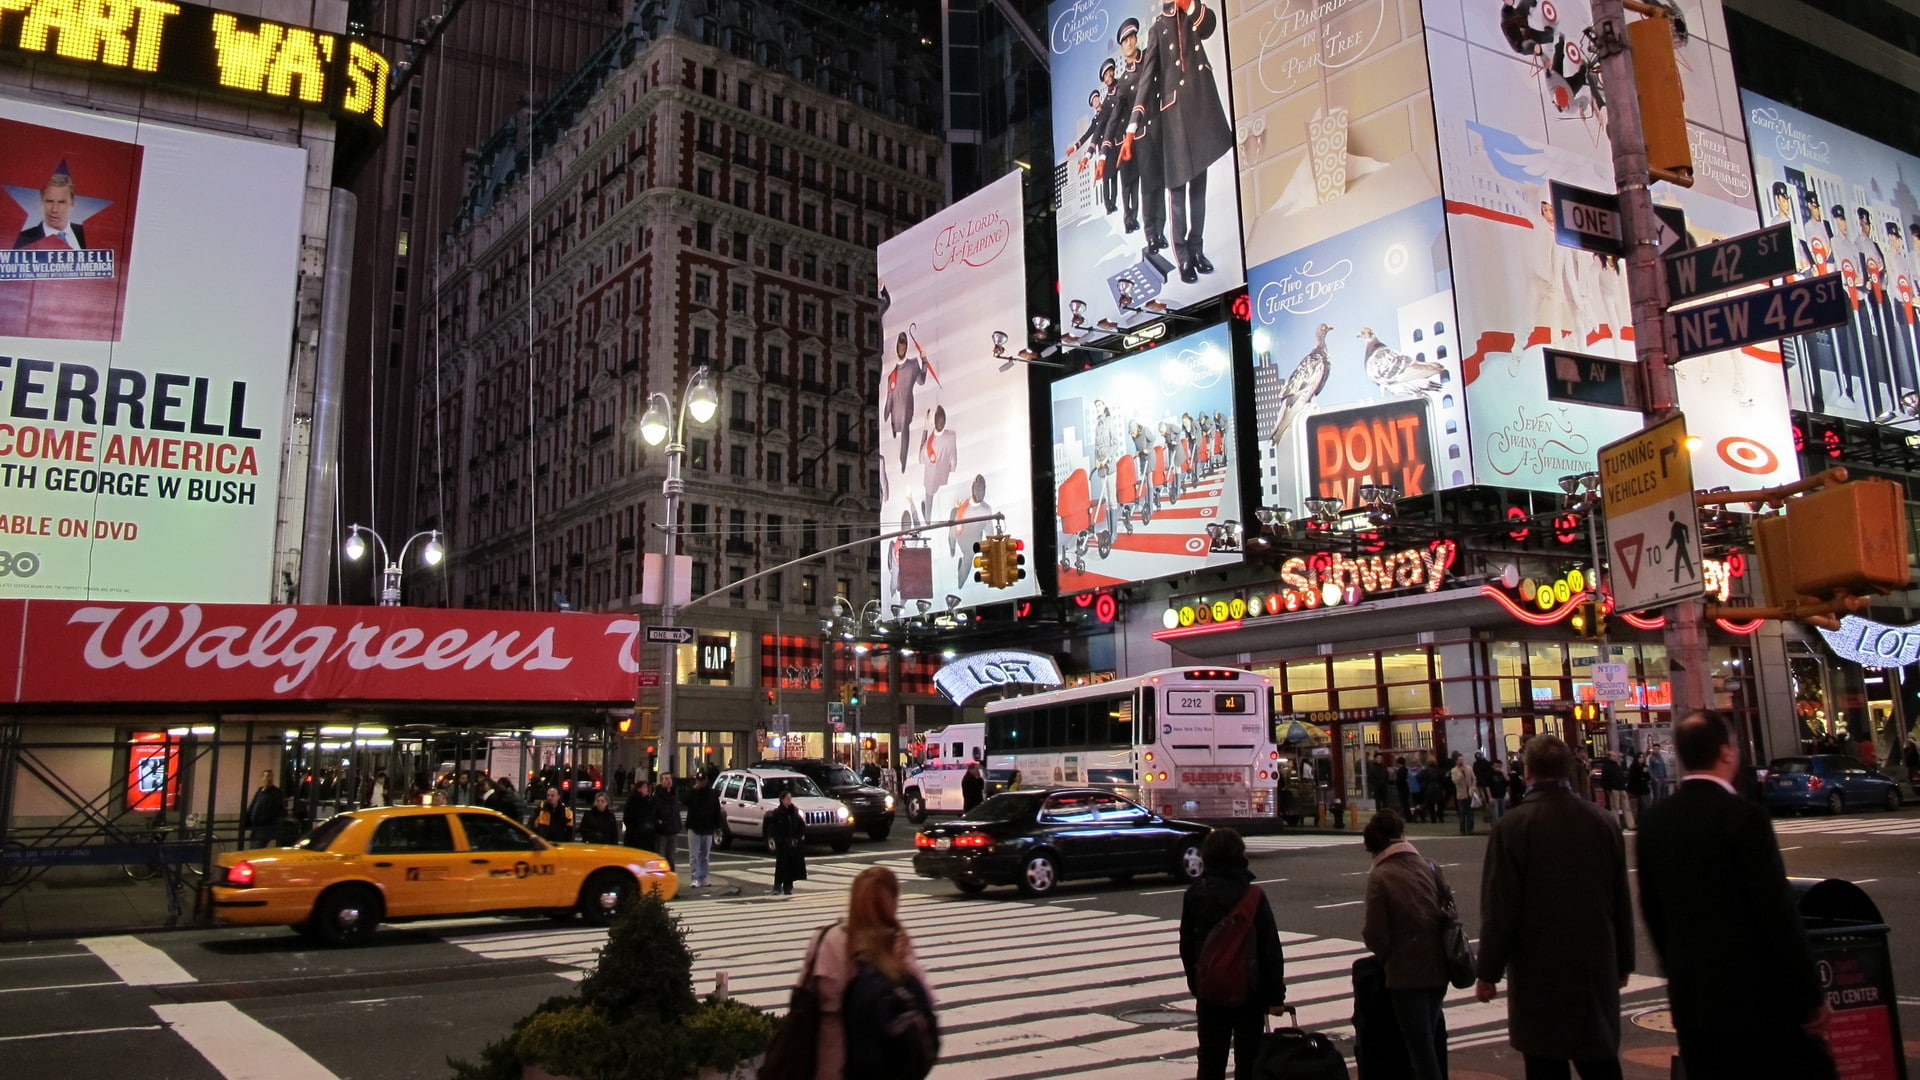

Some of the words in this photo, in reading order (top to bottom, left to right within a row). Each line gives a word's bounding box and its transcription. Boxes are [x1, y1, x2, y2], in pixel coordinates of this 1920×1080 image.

[1063, 12, 1097, 42] CALLING
[1072, 25, 1098, 45] BIRDS
[1303, 31, 1316, 48] IN
[1321, 23, 1331, 38] A
[1281, 53, 1320, 79] PEAR
[1325, 31, 1363, 58] TREE
[1751, 108, 1775, 130] EIGHT
[1696, 131, 1728, 156] TWELVE
[1691, 143, 1741, 174] DRUMMERS
[1699, 160, 1748, 190] DRUMMING
[967, 210, 1000, 238] LORDS
[1572, 206, 1611, 235] ONE
[0, 251, 39, 264] WILL
[47, 251, 113, 264] FERRELL
[0, 263, 31, 273] YOU'RE
[32, 263, 74, 273] WELCOME
[75, 262, 112, 272] AMERICA
[1676, 255, 1697, 296] W
[1711, 244, 1744, 284] 42
[1758, 232, 1780, 256] ST
[1266, 293, 1304, 314] TURTLE
[1305, 279, 1346, 300] DOVES
[1280, 274, 1302, 295] TWO
[1681, 302, 1749, 350] NEW
[1764, 289, 1815, 331] 42
[1816, 281, 1837, 303] ST
[1589, 365, 1607, 383] AV
[1513, 405, 1553, 432] SEVEN
[1316, 414, 1420, 478] DONT
[1498, 425, 1538, 453] SWANS
[103, 434, 259, 477] AMERICA
[1519, 446, 1592, 475] A-SWIMMING
[1604, 440, 1655, 477] TURNING
[45, 466, 150, 498] GEORGE
[157, 476, 182, 500] W
[187, 478, 257, 506] BUSH
[1607, 470, 1657, 505] VEHICLES
[57, 517, 89, 539] ON
[94, 520, 138, 542] DVD
[1281, 541, 1448, 594] Subway
[1645, 544, 1662, 567] TO
[66, 604, 573, 694] Walgreens
[653, 631, 667, 639] ONE
[673, 631, 688, 640] WAY
[1856, 625, 1920, 660] LOF
[704, 645, 727, 670] GAP
[1597, 665, 1621, 673] NYPD
[967, 660, 1036, 685] LOFT
[1595, 681, 1626, 689] SECURITY
[1181, 697, 1202, 708] 2212
[1597, 688, 1626, 696] CAMERA
[1842, 986, 1880, 1004] CENTER
